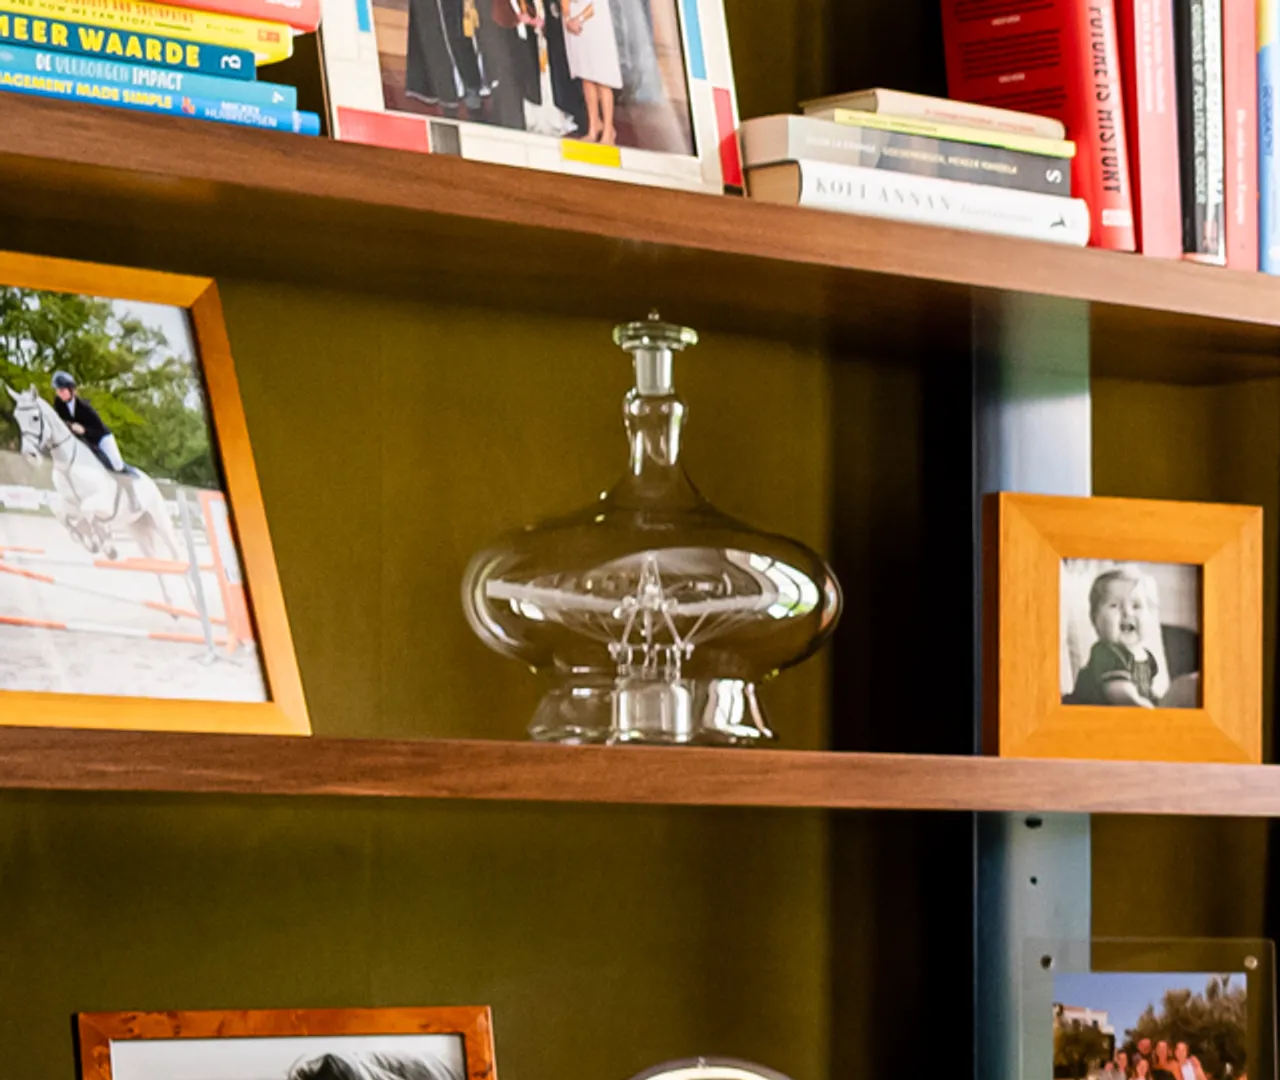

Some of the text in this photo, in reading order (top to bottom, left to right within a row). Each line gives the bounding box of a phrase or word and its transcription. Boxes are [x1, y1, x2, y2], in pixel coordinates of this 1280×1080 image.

[78, 27, 200, 68] WAARDE
[0, 71, 173, 110] AGEMENT MADE SIMPLE
[36, 53, 52, 72] DE
[132, 66, 184, 91] IMPACT
